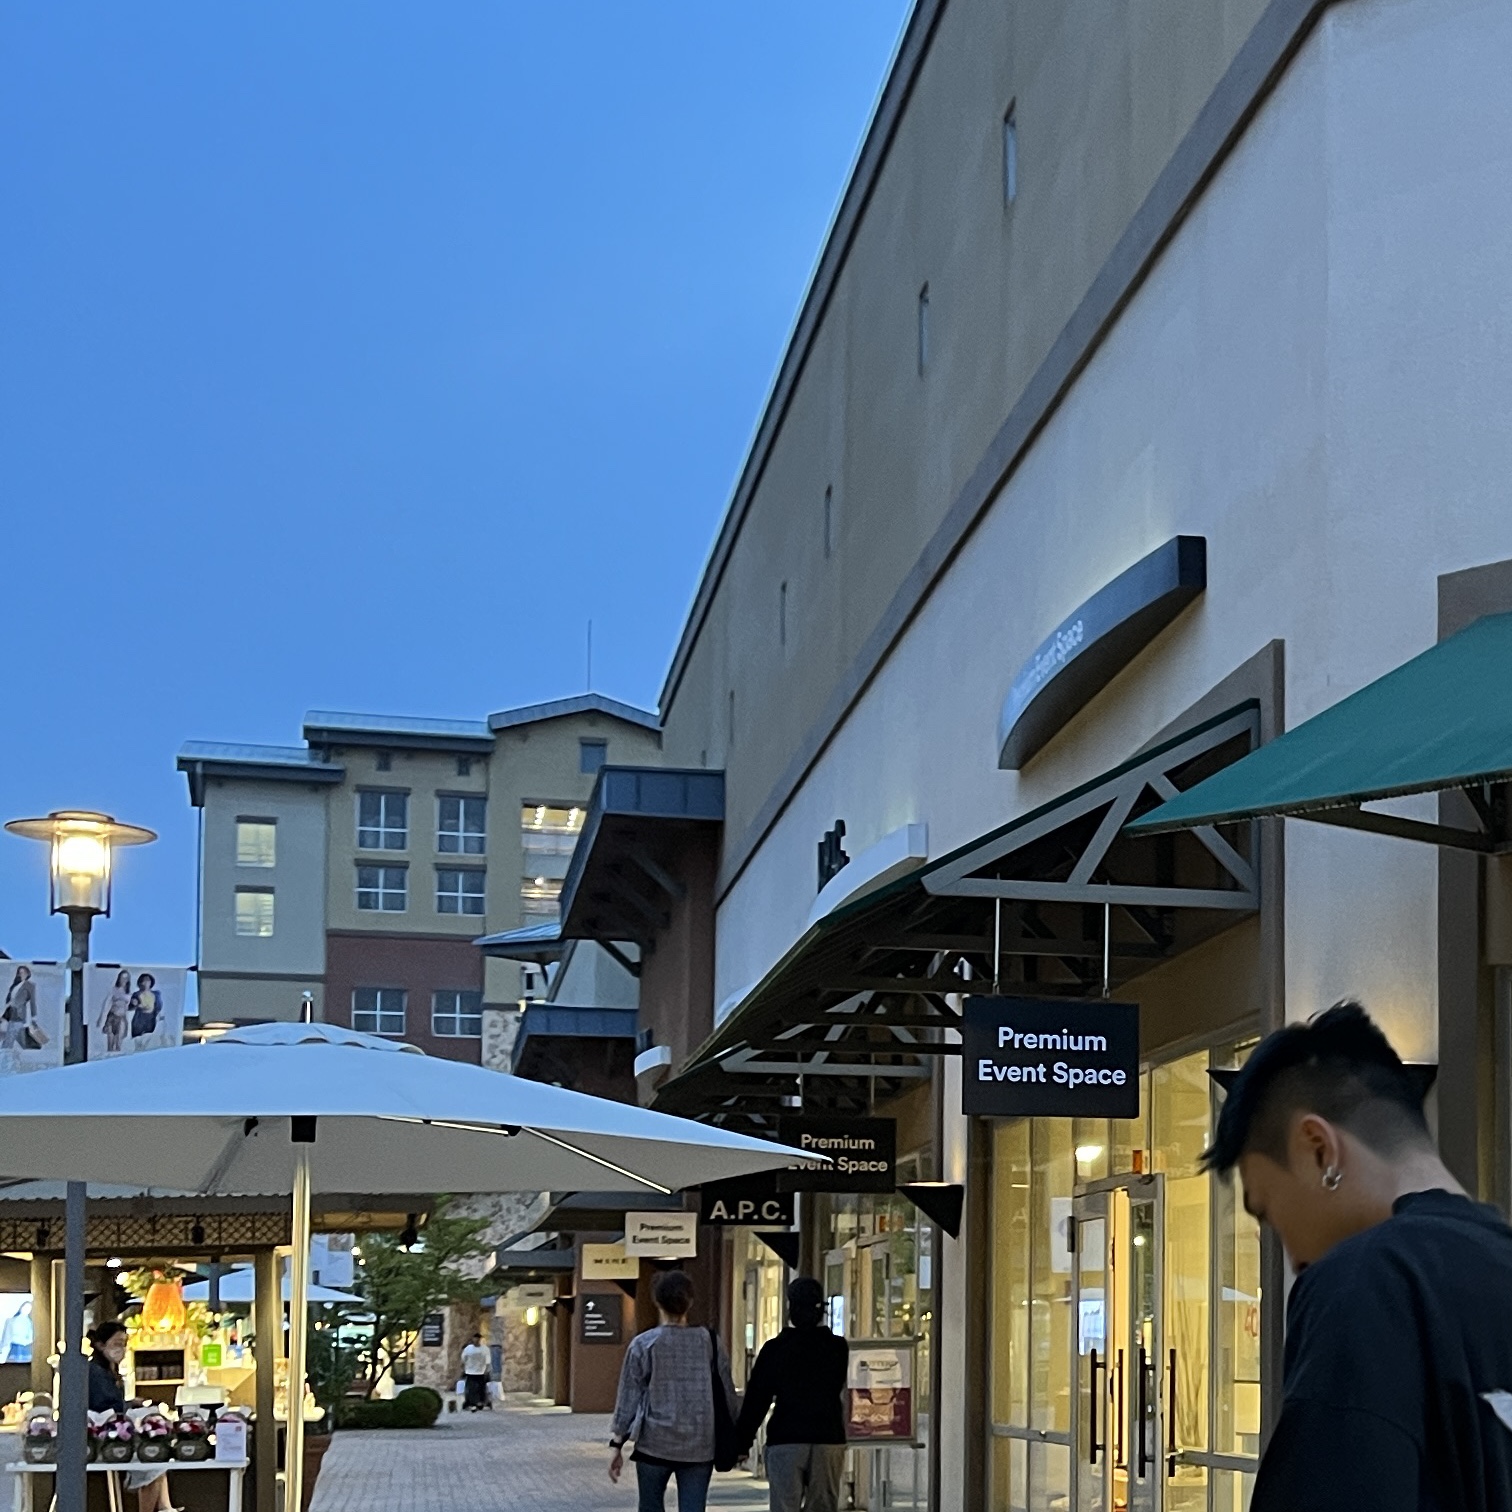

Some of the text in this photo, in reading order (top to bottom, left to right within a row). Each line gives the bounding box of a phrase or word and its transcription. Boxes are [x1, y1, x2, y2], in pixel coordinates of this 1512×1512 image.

[998, 1026, 1107, 1051] Premium
[978, 1059, 1127, 1088] Event Space
[801, 1133, 875, 1150] Premium
[837, 1156, 888, 1174] Space
[709, 1200, 787, 1220] A.P.C.
